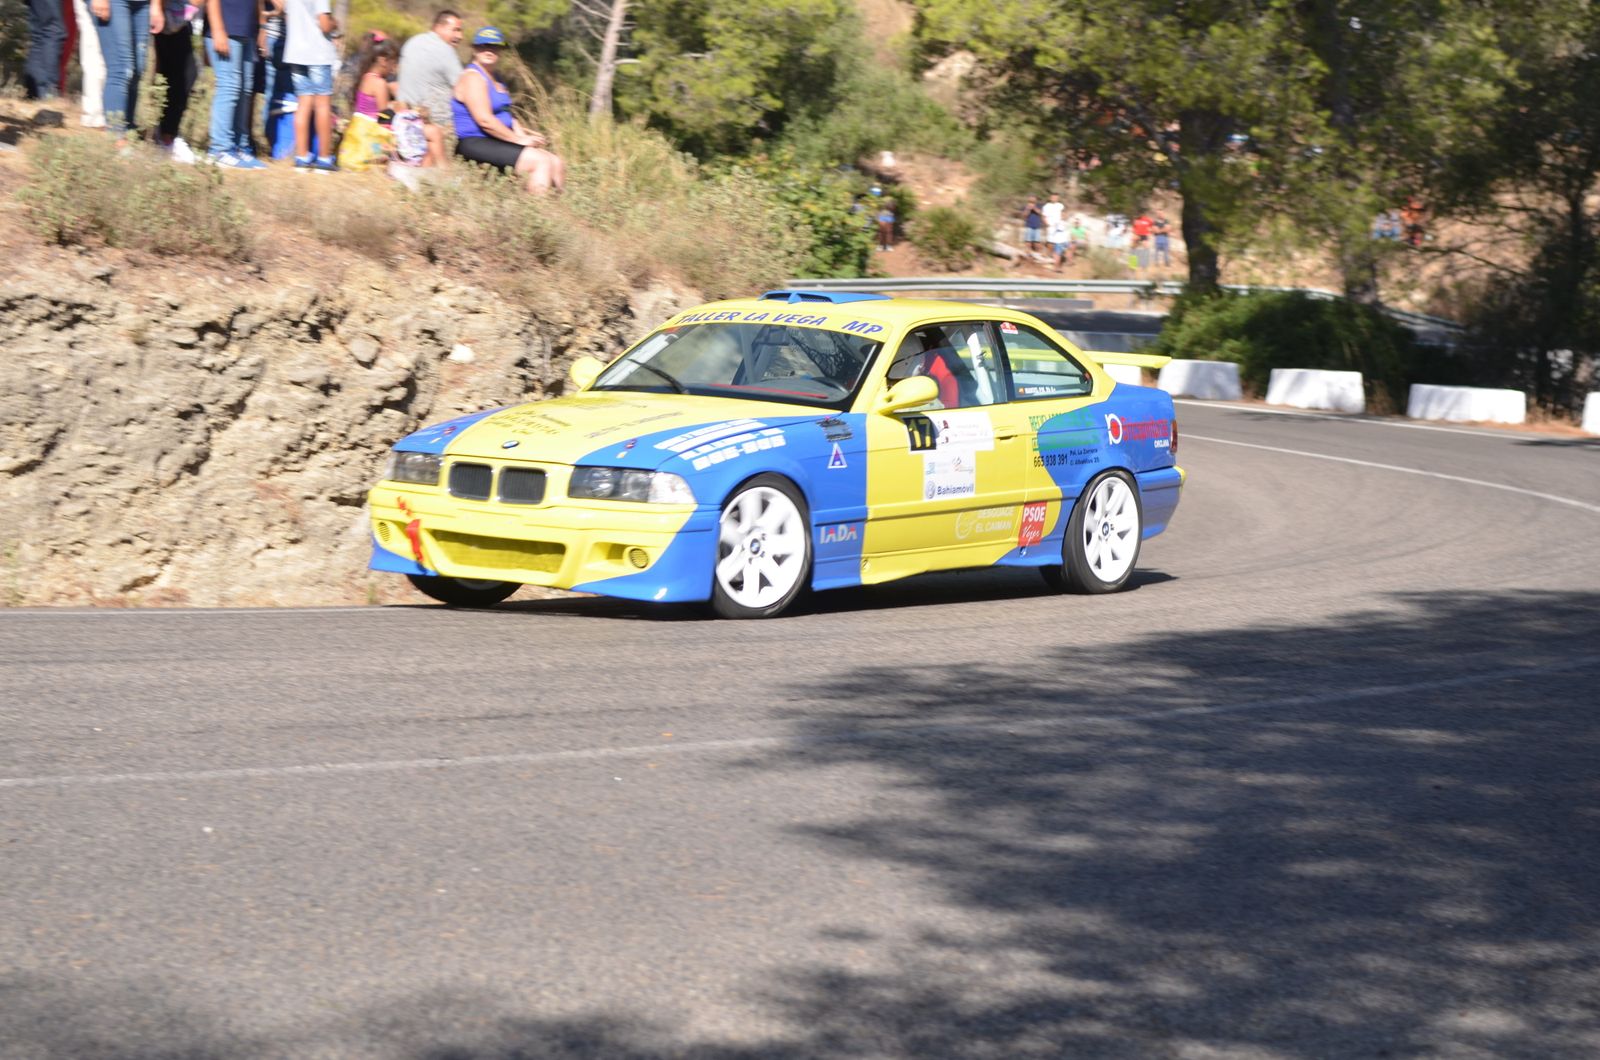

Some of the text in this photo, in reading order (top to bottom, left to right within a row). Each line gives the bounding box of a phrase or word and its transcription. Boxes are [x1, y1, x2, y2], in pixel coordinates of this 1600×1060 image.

[674, 312, 884, 335] TALLER LA VEGA MP
[1023, 506, 1046, 522] PSOE
